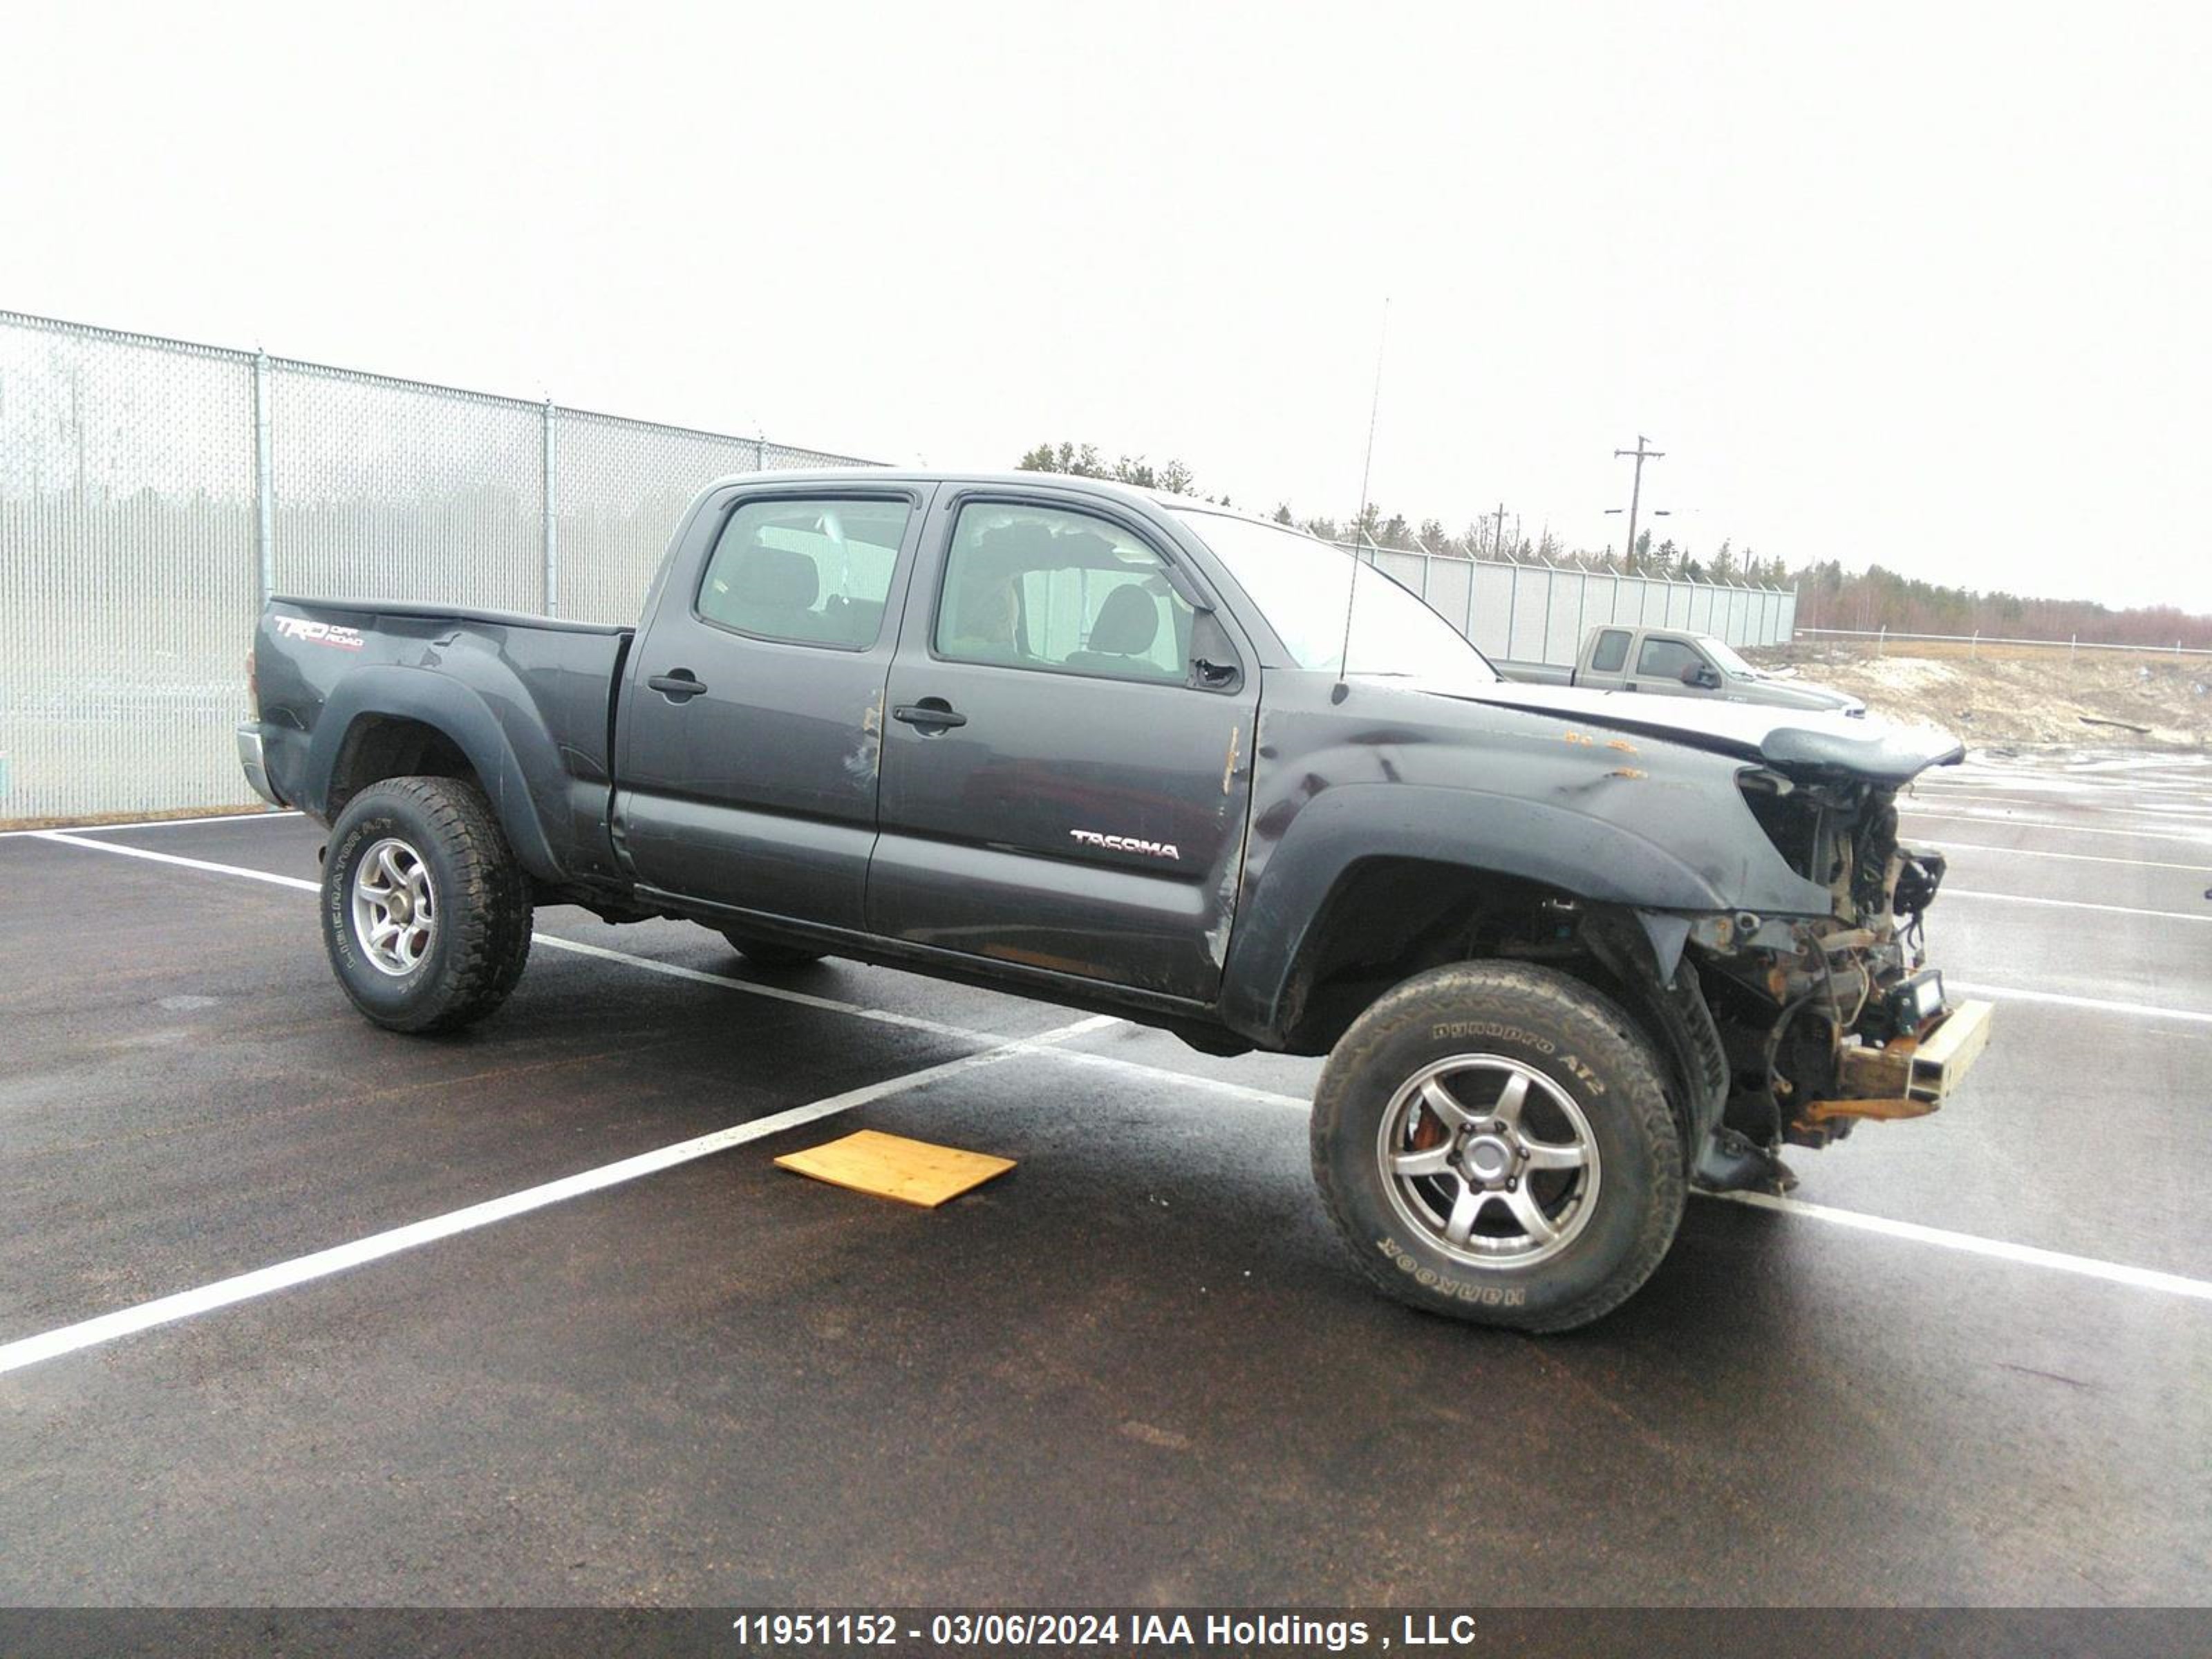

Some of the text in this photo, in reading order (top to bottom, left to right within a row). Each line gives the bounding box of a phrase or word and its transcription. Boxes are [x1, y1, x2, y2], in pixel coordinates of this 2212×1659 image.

[274, 615, 359, 641] TRD OFF
[325, 633, 364, 646] ROAD
[1069, 830, 1180, 861] TACOMA
